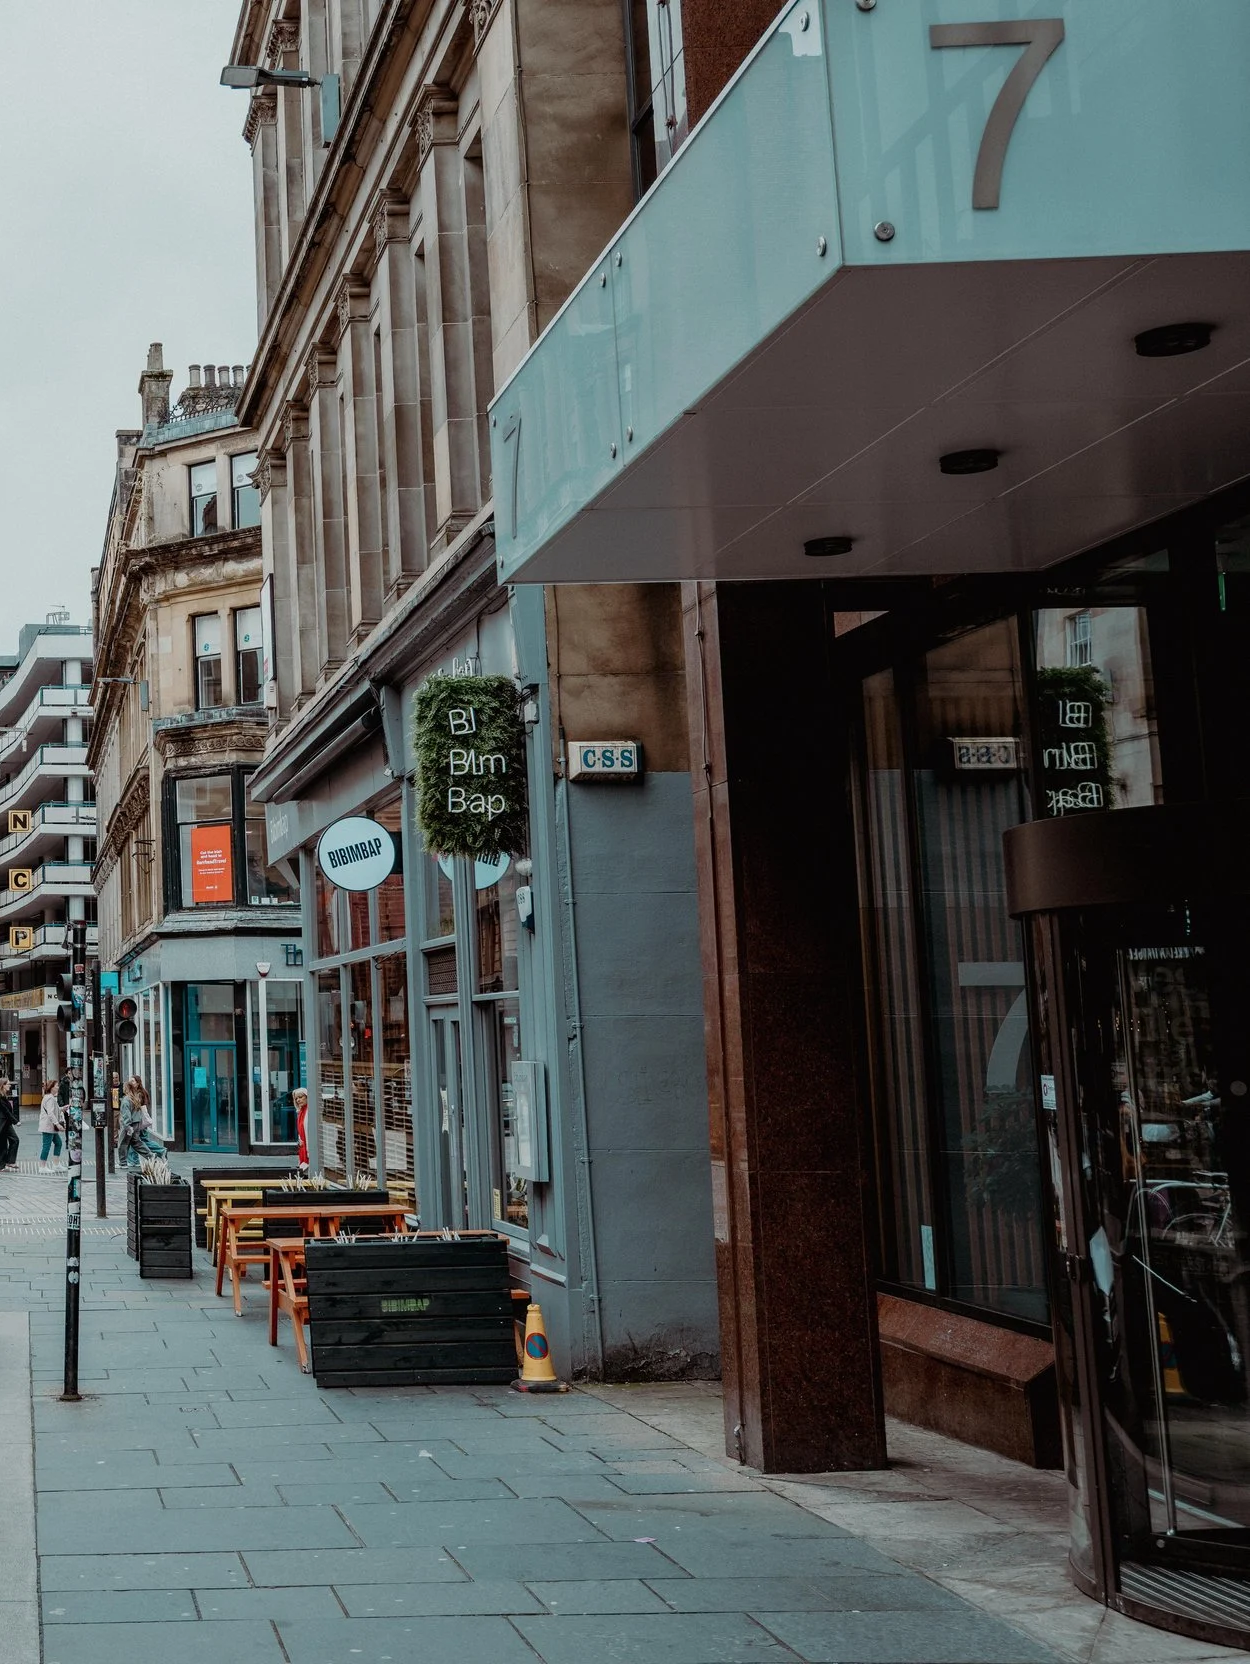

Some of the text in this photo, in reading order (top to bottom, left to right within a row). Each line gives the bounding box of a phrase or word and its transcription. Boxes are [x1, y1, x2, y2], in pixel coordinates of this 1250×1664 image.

[929, 18, 1065, 210] 7
[448, 787, 505, 822] Bap
[12, 813, 28, 946] N C P
[327, 837, 382, 869] BIBIMBAP
